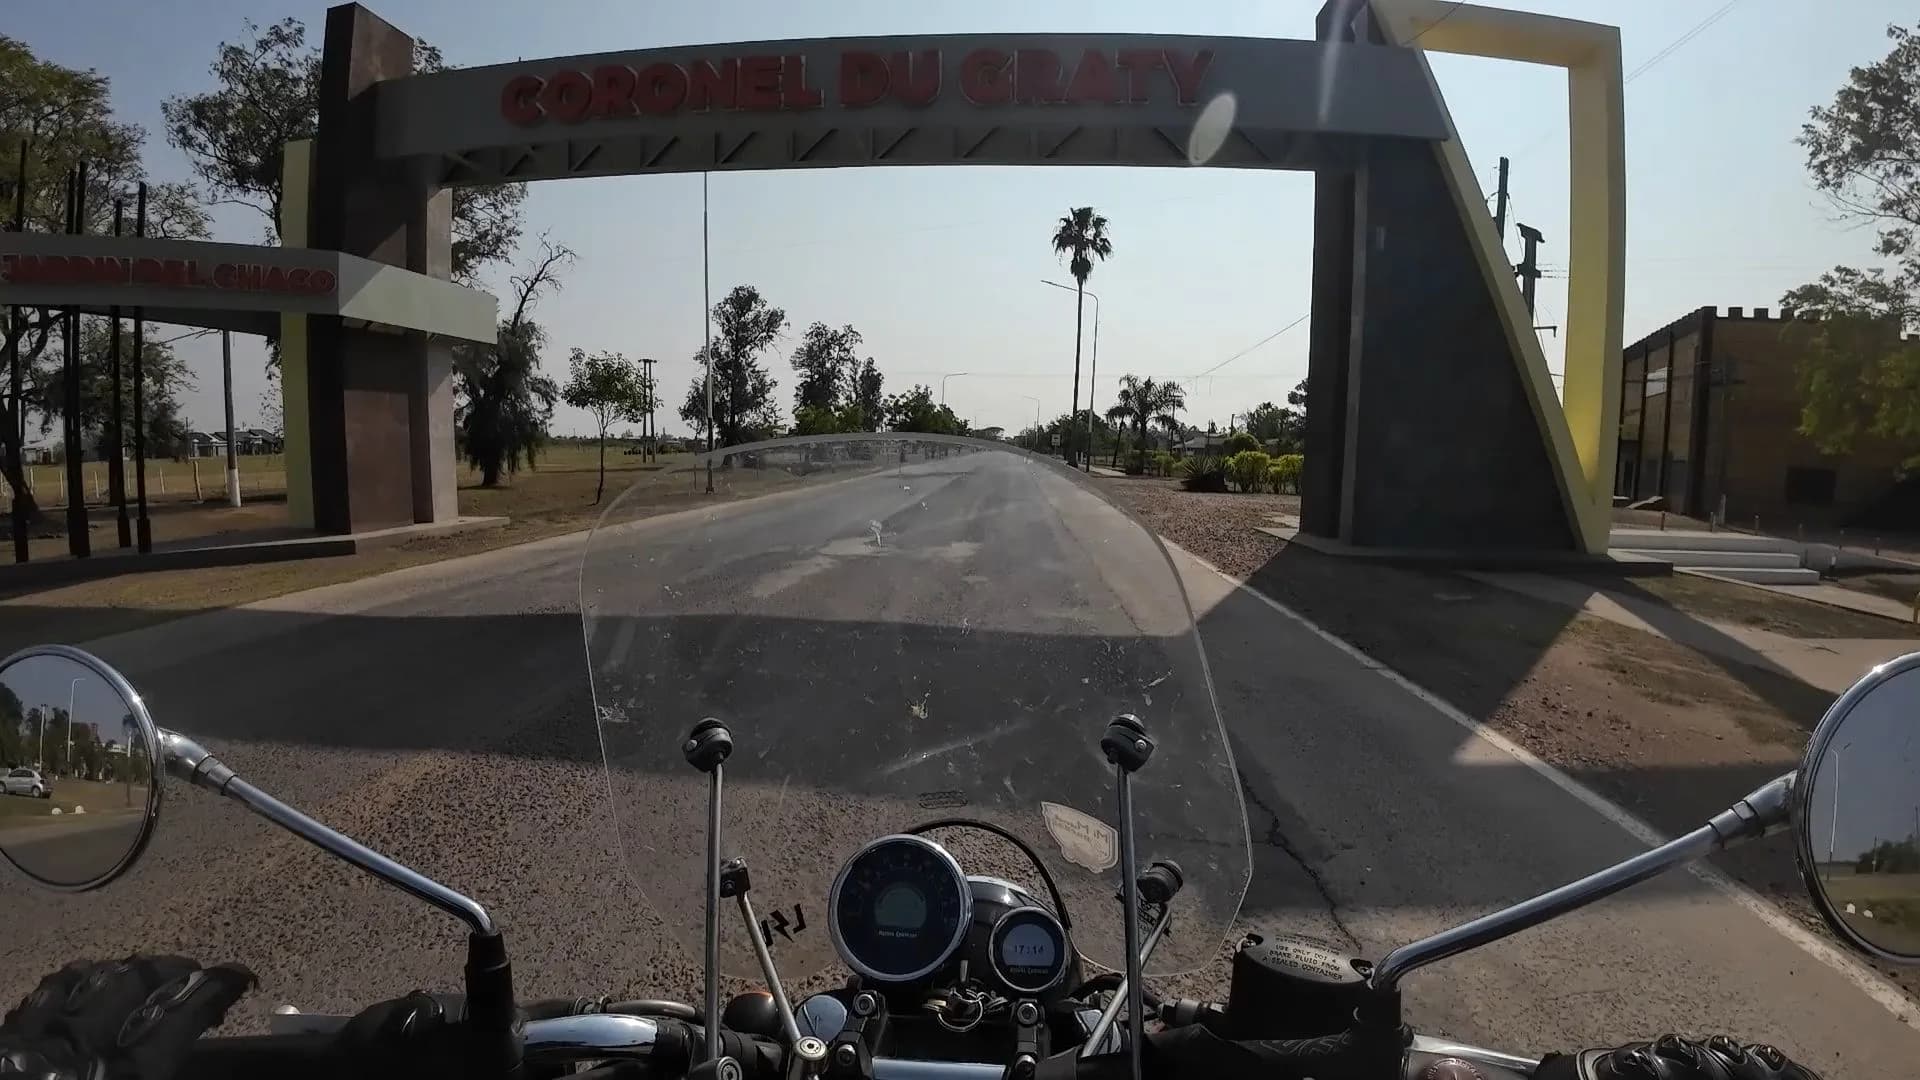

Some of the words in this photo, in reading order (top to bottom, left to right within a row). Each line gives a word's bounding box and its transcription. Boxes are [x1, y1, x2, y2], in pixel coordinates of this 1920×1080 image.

[501, 55, 825, 127] CORONEL
[838, 50, 943, 108] DU
[958, 48, 1215, 107] GRATY
[1, 254, 133, 287] JARDIN
[134, 256, 210, 289] DEL
[211, 262, 337, 294] CHACO
[1269, 950, 1292, 959] BRAKE
[1295, 954, 1318, 965] FLUID
[1301, 963, 1343, 981] CONTAINER
